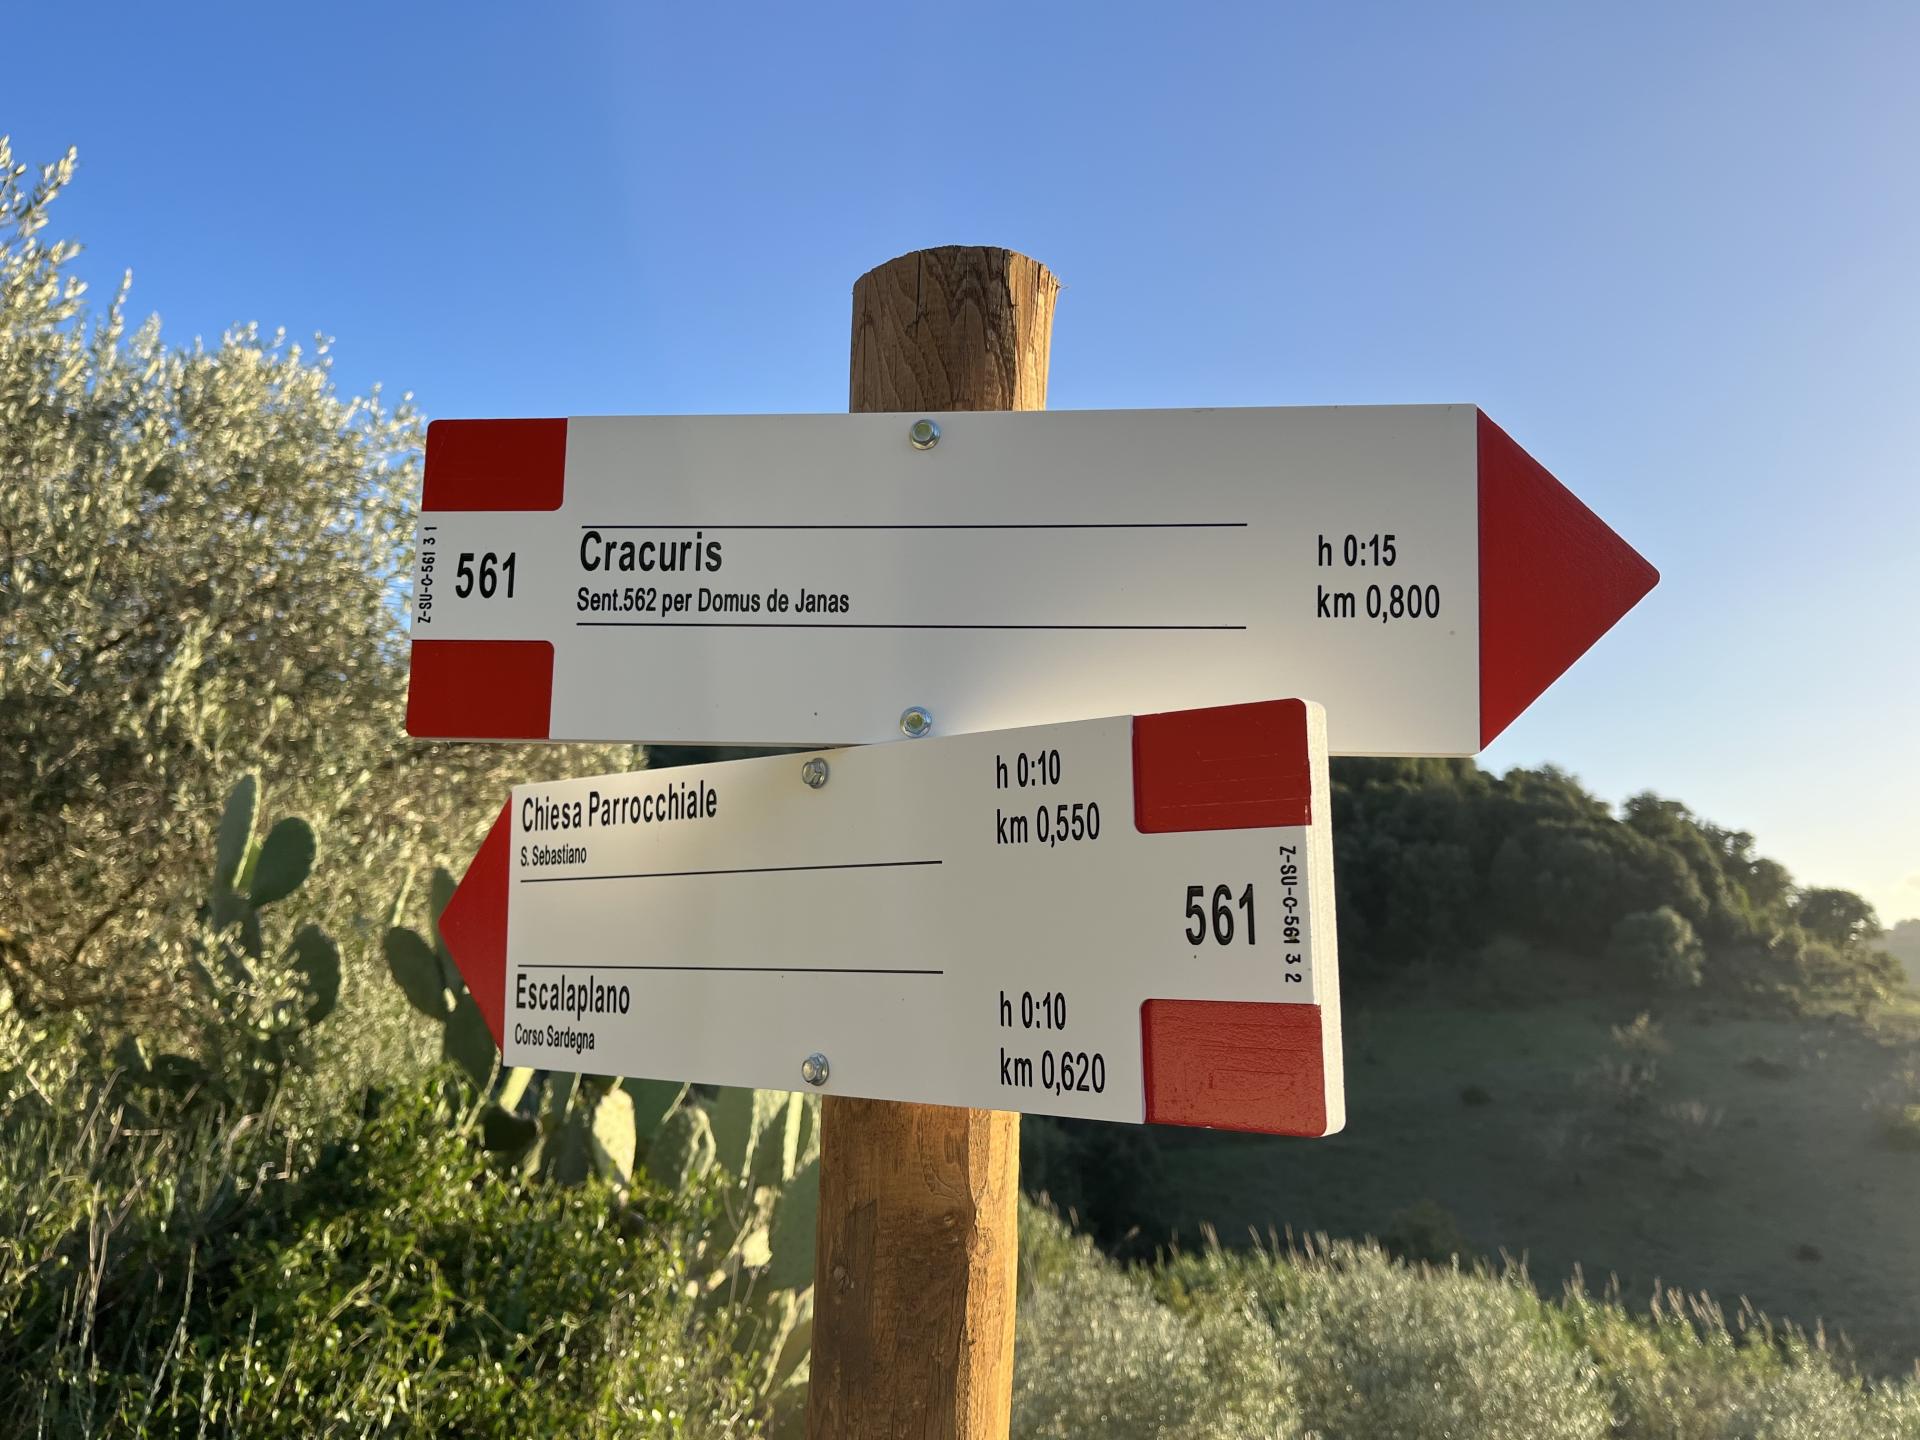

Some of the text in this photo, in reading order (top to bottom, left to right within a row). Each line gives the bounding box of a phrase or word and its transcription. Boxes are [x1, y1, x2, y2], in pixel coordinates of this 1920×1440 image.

[422, 537, 436, 546] 3
[580, 530, 722, 572] Cracuris
[1318, 533, 1397, 567] h 0:15
[455, 551, 516, 599] 561
[576, 586, 850, 618] Sent.562 per Domus de Janas
[1317, 584, 1440, 624] km 0,800
[996, 749, 1061, 790] h 0:10
[522, 779, 718, 833] Chiesa Parrocchiale
[996, 801, 1100, 849] km 0,550
[520, 843, 587, 867] S. Sebastiano
[1185, 883, 1256, 946] 561
[1284, 972, 1302, 983] 2
[1285, 953, 1302, 965] 3
[516, 973, 630, 1022] Escalaplano
[999, 990, 1067, 1031] h 0:10
[514, 1022, 595, 1055] Corso Sardegna
[1000, 1047, 1106, 1097] km 0,620
